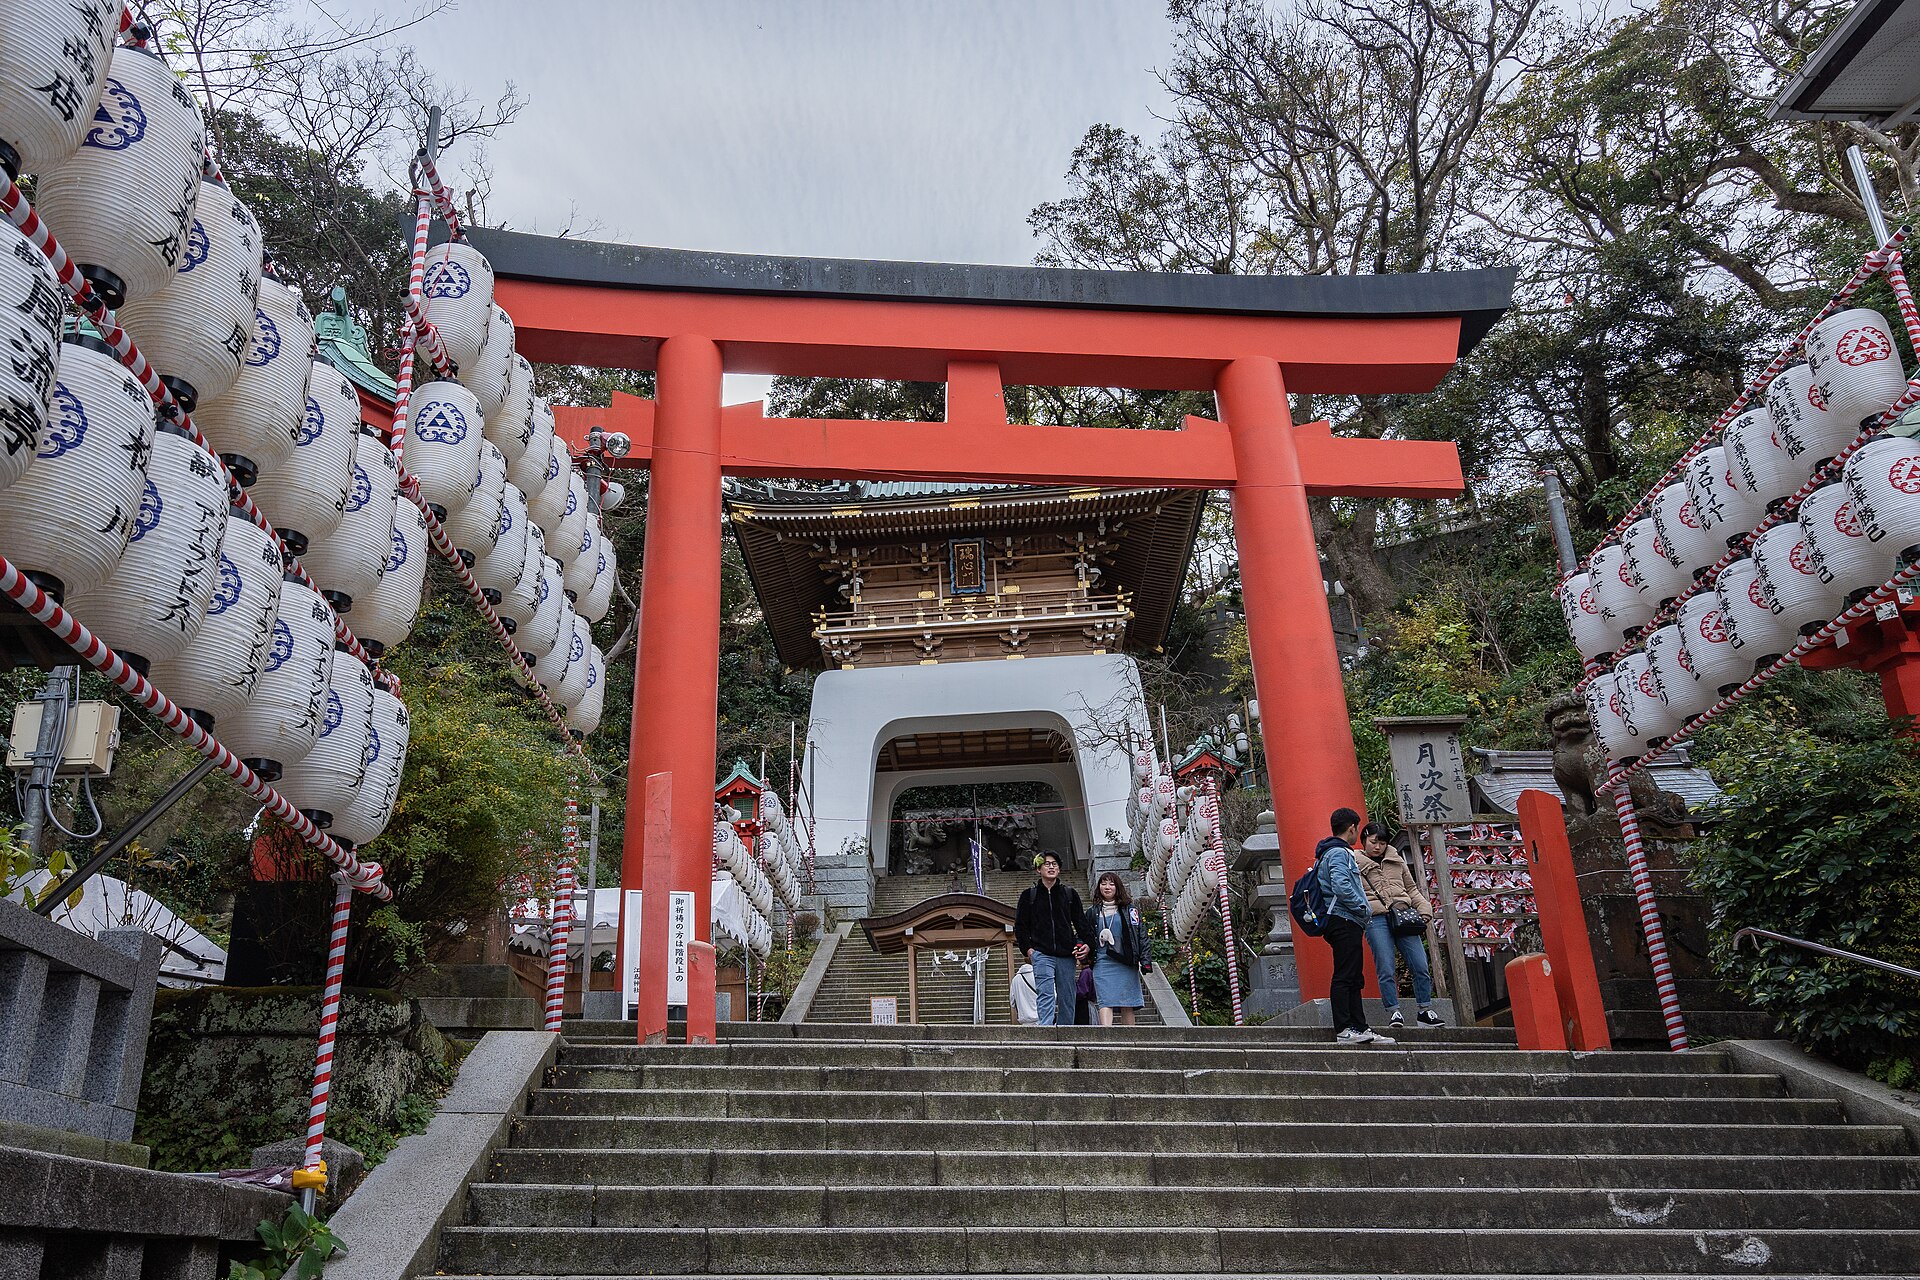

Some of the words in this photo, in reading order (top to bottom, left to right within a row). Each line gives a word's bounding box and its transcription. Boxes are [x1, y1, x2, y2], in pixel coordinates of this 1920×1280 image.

[1400, 784, 1416, 821] 江島神社
[1416, 743, 1453, 822] 月次祭
[675, 897, 685, 983] 御祈祷の方は階段上の
